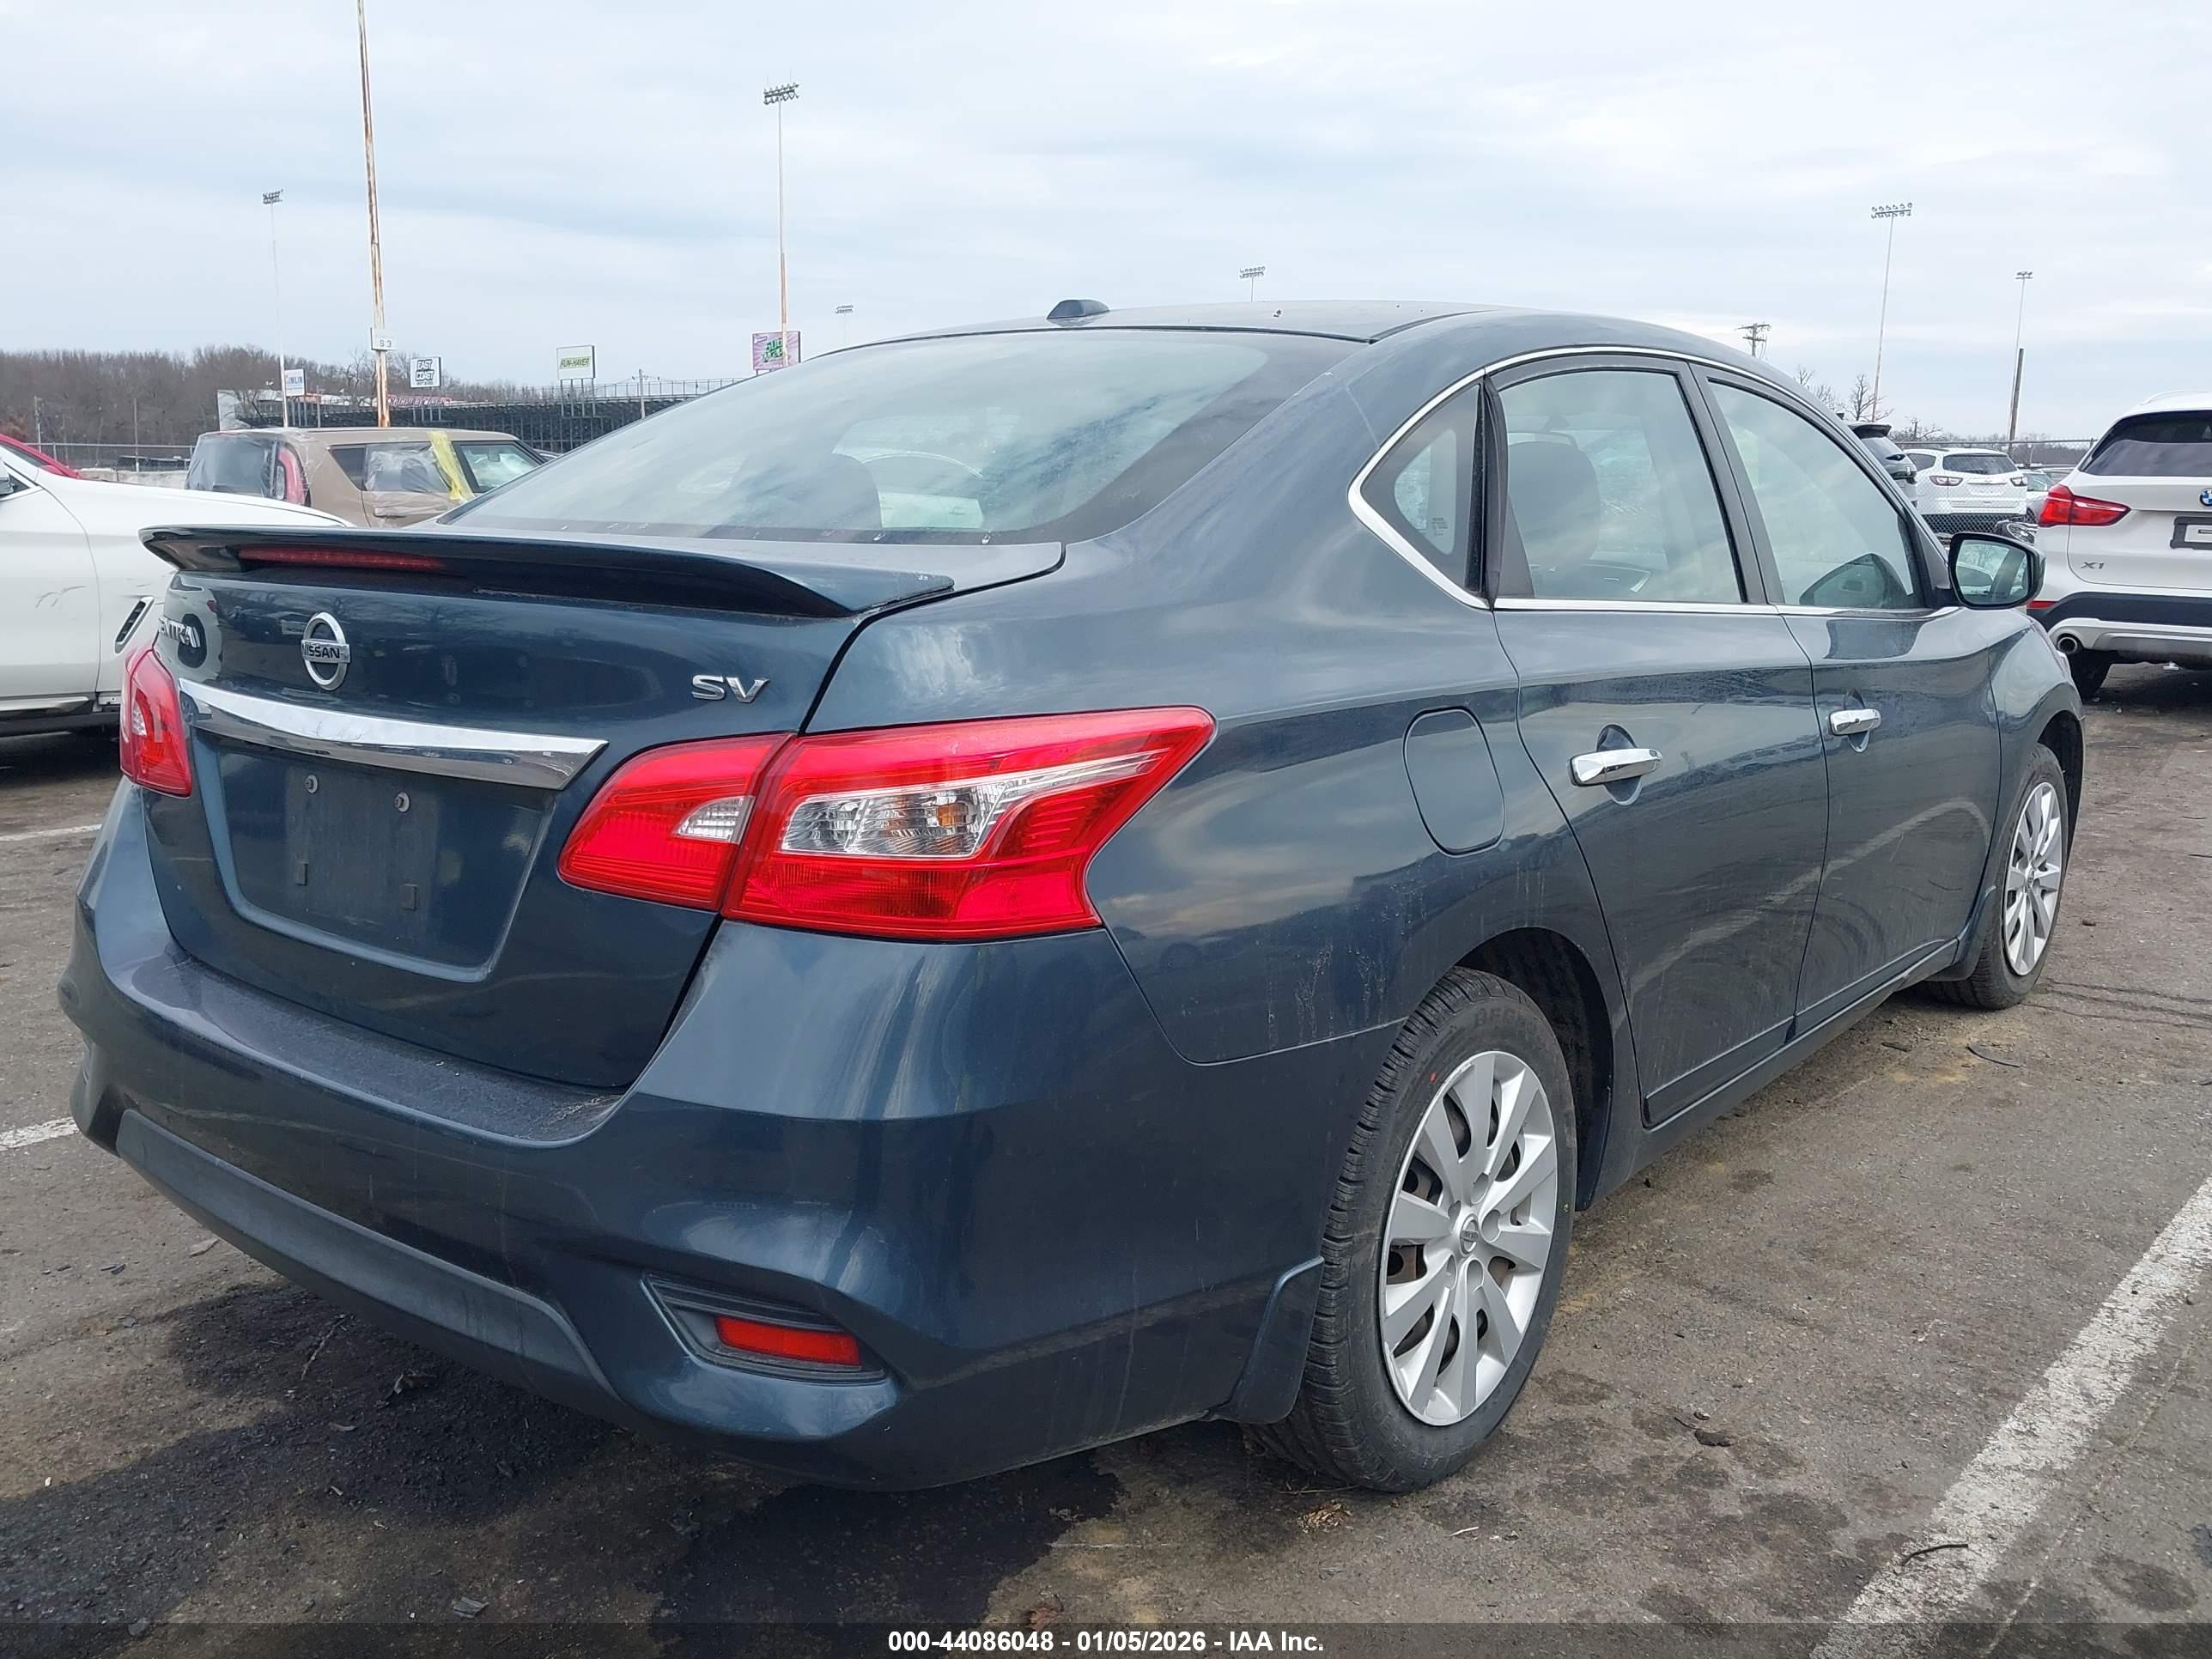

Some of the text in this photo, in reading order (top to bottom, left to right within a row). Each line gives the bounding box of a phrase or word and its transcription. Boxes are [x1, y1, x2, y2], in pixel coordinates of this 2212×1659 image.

[417, 359, 433, 370] EAST
[416, 369, 434, 381] COAST
[302, 642, 340, 659] NISSAN
[691, 675, 769, 702] SV
